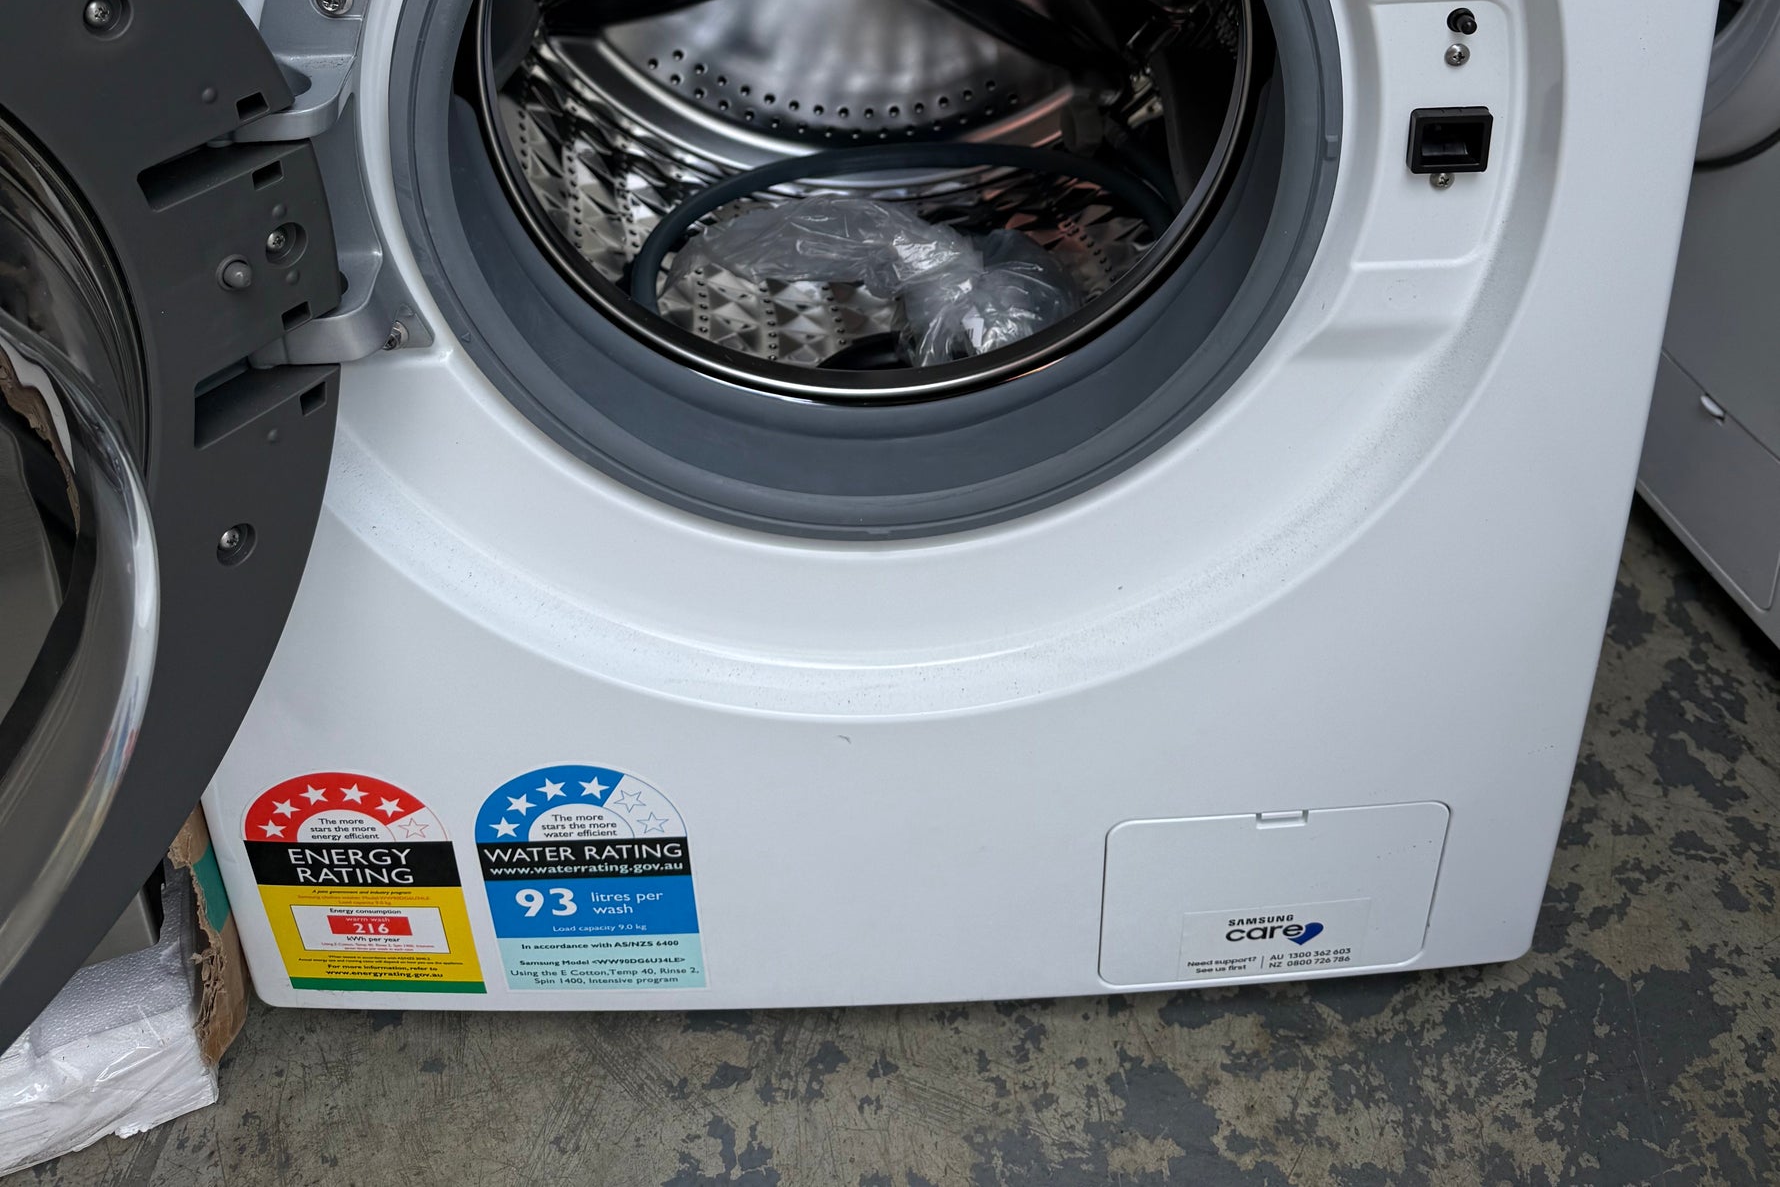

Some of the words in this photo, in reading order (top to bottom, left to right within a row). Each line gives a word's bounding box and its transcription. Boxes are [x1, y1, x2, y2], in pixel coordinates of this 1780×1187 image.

[552, 814, 572, 822] The
[577, 829, 618, 837] efficient
[288, 849, 412, 865] ENERGY
[484, 846, 576, 863] WATER
[584, 842, 683, 861] RATING
[490, 861, 683, 876] www.waterrating.gov.au
[296, 867, 414, 884] RATING
[515, 887, 578, 917] 93
[590, 891, 631, 902] litres
[635, 892, 664, 904] per
[330, 907, 354, 915] Energy
[593, 904, 633, 914] wash
[1228, 914, 1294, 927] SAMSUNG
[353, 923, 390, 934] 216
[578, 924, 616, 932] capacity
[635, 923, 647, 931] kg
[1225, 923, 1304, 942] care
[614, 940, 653, 948] AS/NZS
[1288, 951, 1312, 960] 1300
[1313, 949, 1332, 957] 362
[1332, 947, 1352, 956] 603
[1187, 959, 1213, 967] Need
[1214, 956, 1257, 967] support?
[1268, 961, 1283, 969] NZ
[1286, 958, 1313, 968] 0800
[1314, 956, 1332, 965] 726
[1332, 955, 1351, 963] 786
[510, 969, 539, 977] Using
[1228, 964, 1247, 972] first
[326, 970, 443, 978] www.energyrating.gov.au
[534, 977, 555, 985] Spin
[588, 976, 633, 984] Intensive
[636, 976, 679, 985] program
